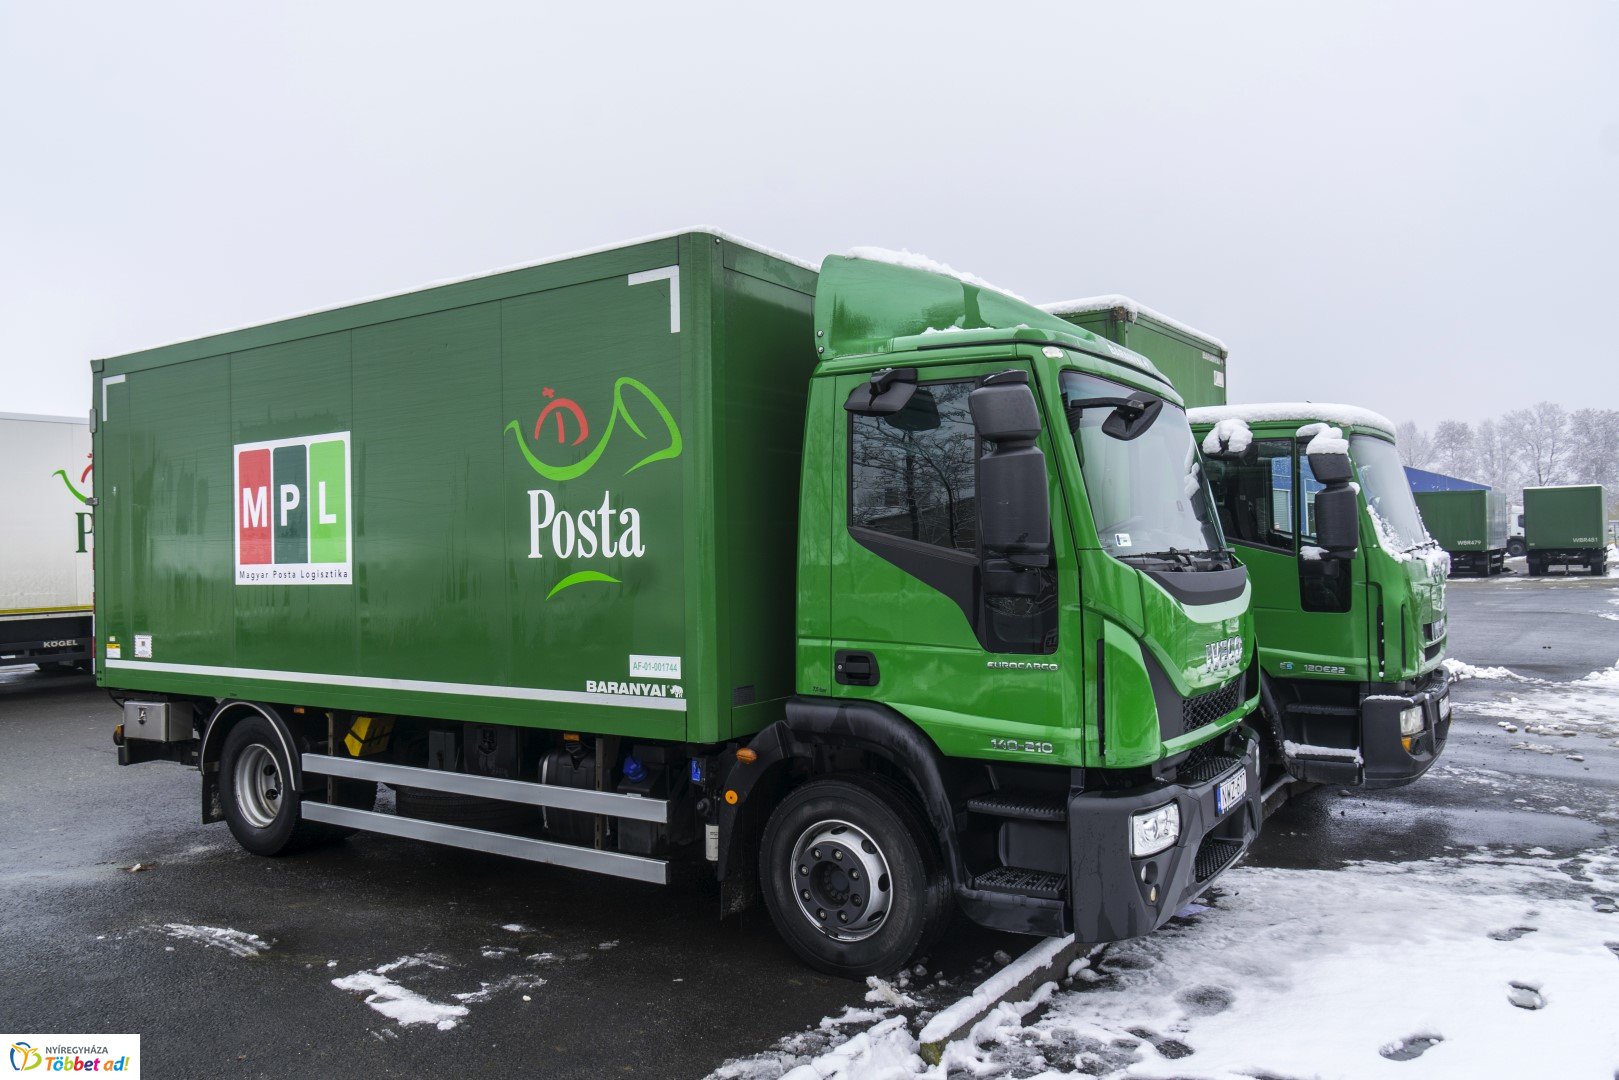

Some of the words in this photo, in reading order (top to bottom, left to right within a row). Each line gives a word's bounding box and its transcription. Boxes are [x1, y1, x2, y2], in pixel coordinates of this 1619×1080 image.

[527, 489, 645, 559] Posta
[239, 570, 269, 581] Magyar
[272, 570, 296, 579] Posta
[300, 569, 349, 581] Logisztika
[1205, 635, 1243, 674] IVECO
[632, 661, 678, 672] AF-01-001744
[986, 661, 1059, 671] EUROCARGO
[1303, 664, 1346, 674] 120E22
[586, 680, 667, 697] BARANYAI
